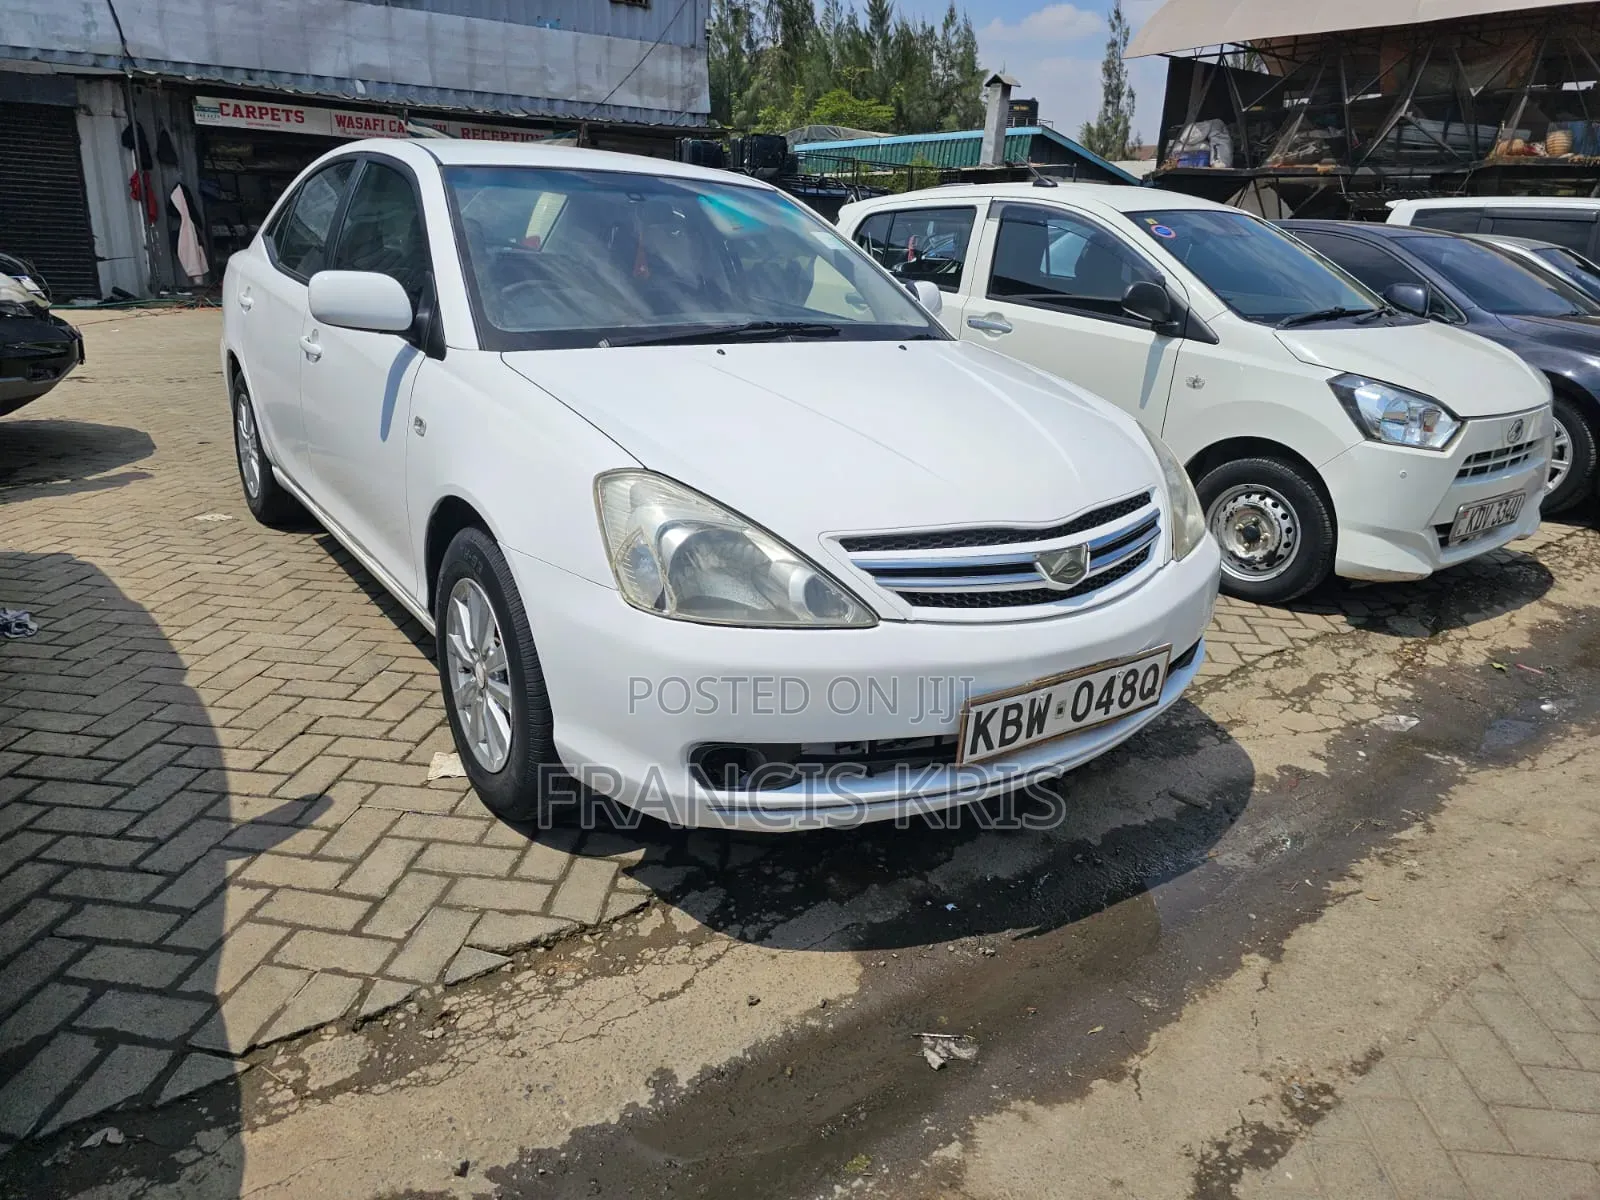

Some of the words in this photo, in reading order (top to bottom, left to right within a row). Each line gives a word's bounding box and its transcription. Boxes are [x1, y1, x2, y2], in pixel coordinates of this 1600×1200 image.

[219, 102, 305, 124] CARPETS
[335, 114, 385, 132] WASAFI
[969, 693, 1053, 755] KBW
[1070, 662, 1160, 723] 048Q
